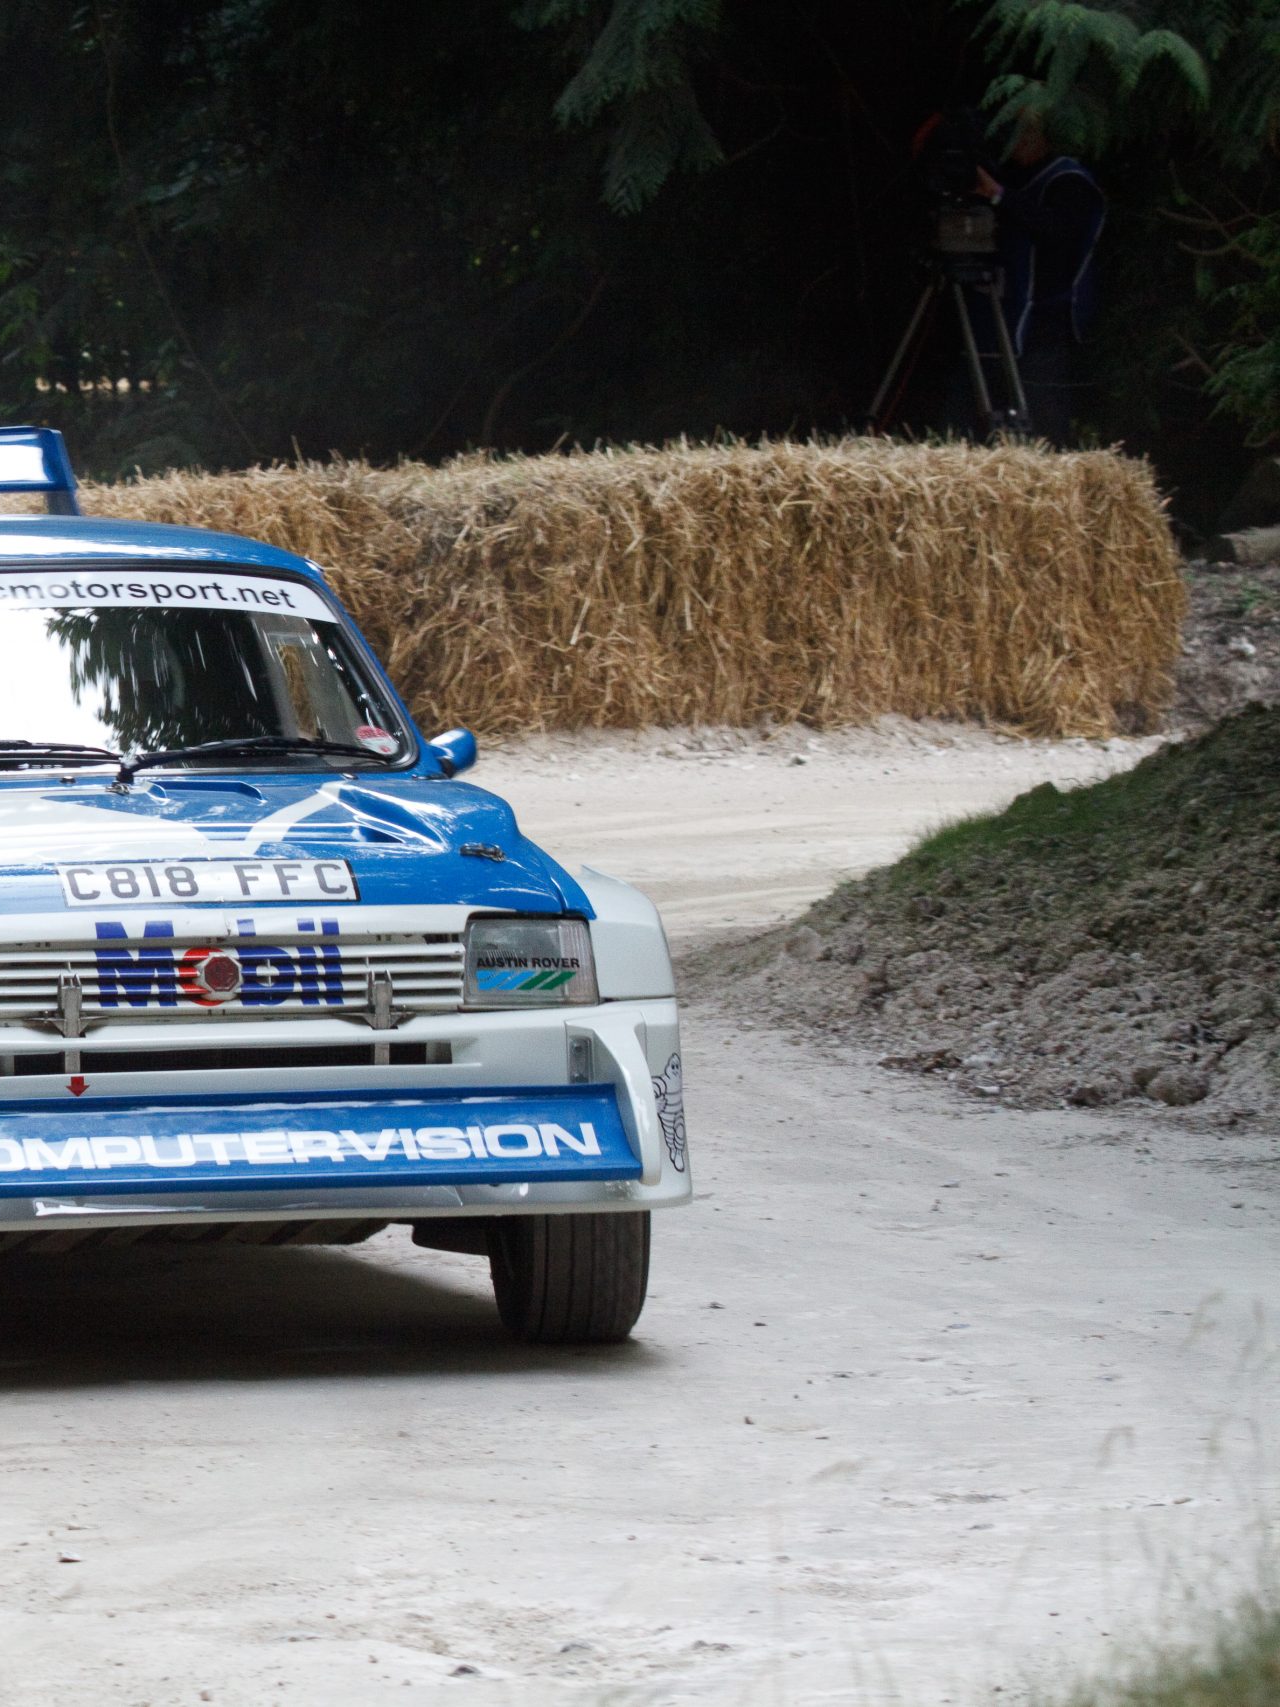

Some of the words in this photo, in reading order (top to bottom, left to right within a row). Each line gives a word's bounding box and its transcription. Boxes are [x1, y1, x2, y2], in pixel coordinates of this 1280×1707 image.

[65, 865, 200, 901] C818
[233, 863, 348, 897] FFC
[476, 957, 529, 969] AUSTIN
[532, 957, 580, 969] ROVER
